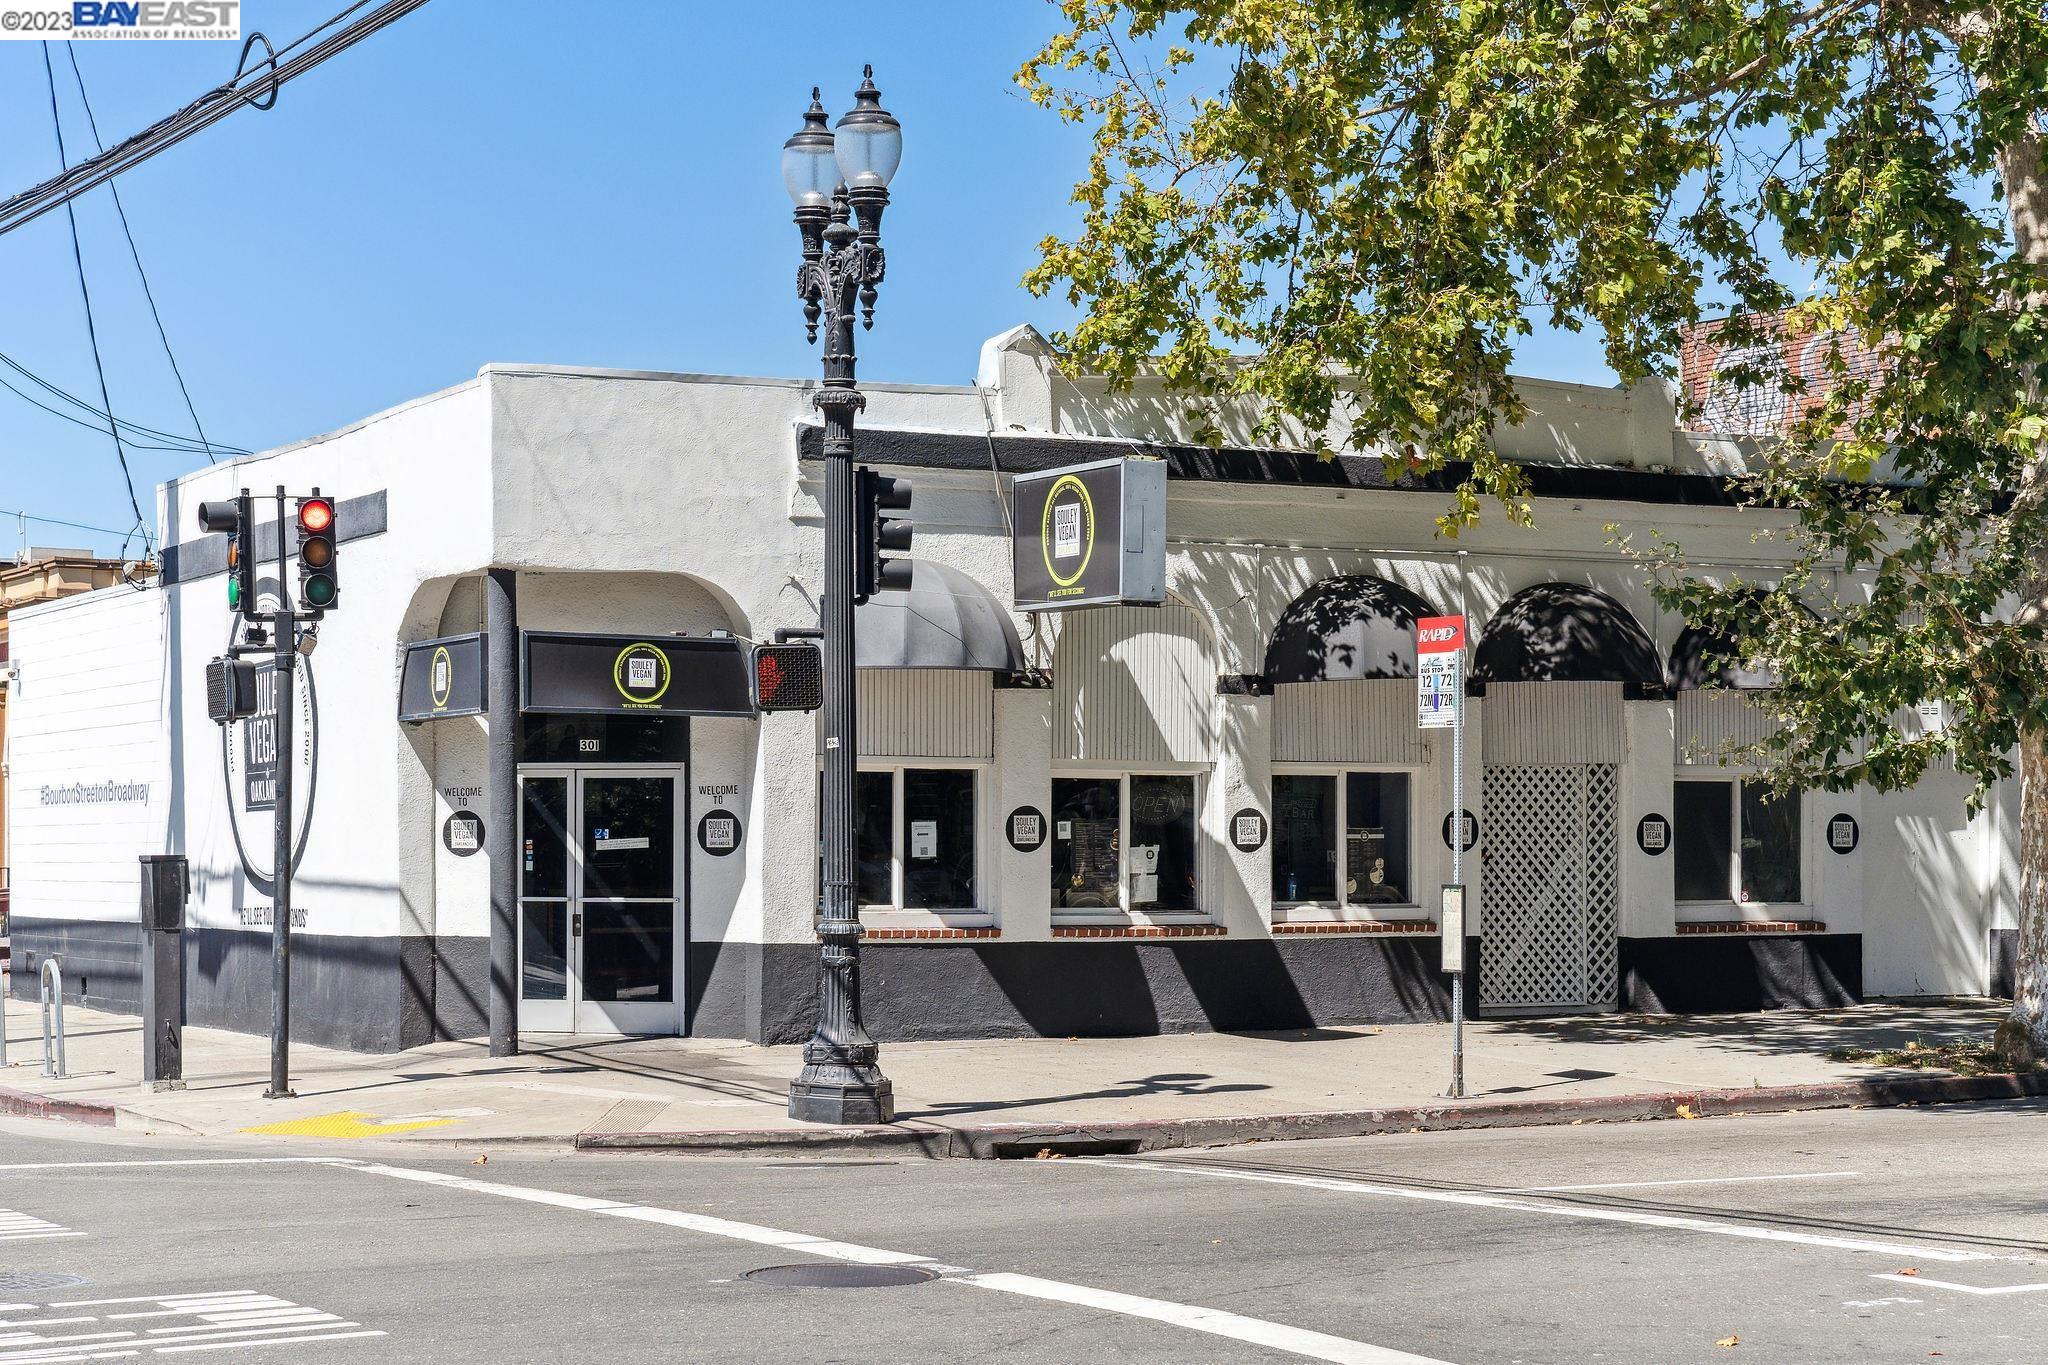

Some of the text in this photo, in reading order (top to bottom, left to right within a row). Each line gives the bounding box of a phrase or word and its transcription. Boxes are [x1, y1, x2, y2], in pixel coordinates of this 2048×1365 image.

[1057, 508, 1078, 525] SOULEY
[1058, 524, 1077, 541] VEGAN
[1419, 627, 1455, 643] RAPID
[631, 660, 654, 670] SOULEY
[632, 669, 652, 679] VEGAN
[1422, 673, 1452, 688] 12 72
[1420, 693, 1453, 707] 72M 72R
[301, 685, 310, 726] SINCE
[250, 719, 277, 765] VEGA
[581, 740, 598, 750] 301
[40, 779, 150, 807] #BourbonStreetonBroadway
[444, 787, 482, 797] WELCOME
[698, 784, 739, 795] WELCOME
[458, 797, 468, 806] TO
[713, 795, 723, 805] TO
[453, 821, 475, 831] SOULEY
[708, 820, 731, 830] SOULEY
[1016, 817, 1037, 826] SOULEY
[1016, 826, 1036, 835] VEGAN
[1645, 823, 1663, 831] SOULEY
[1834, 823, 1850, 831] SOULEY
[454, 830, 474, 840] VEGAN
[709, 829, 730, 839] VEGAN
[1645, 831, 1662, 839] VEGAN
[1835, 831, 1850, 839] VEGAN
